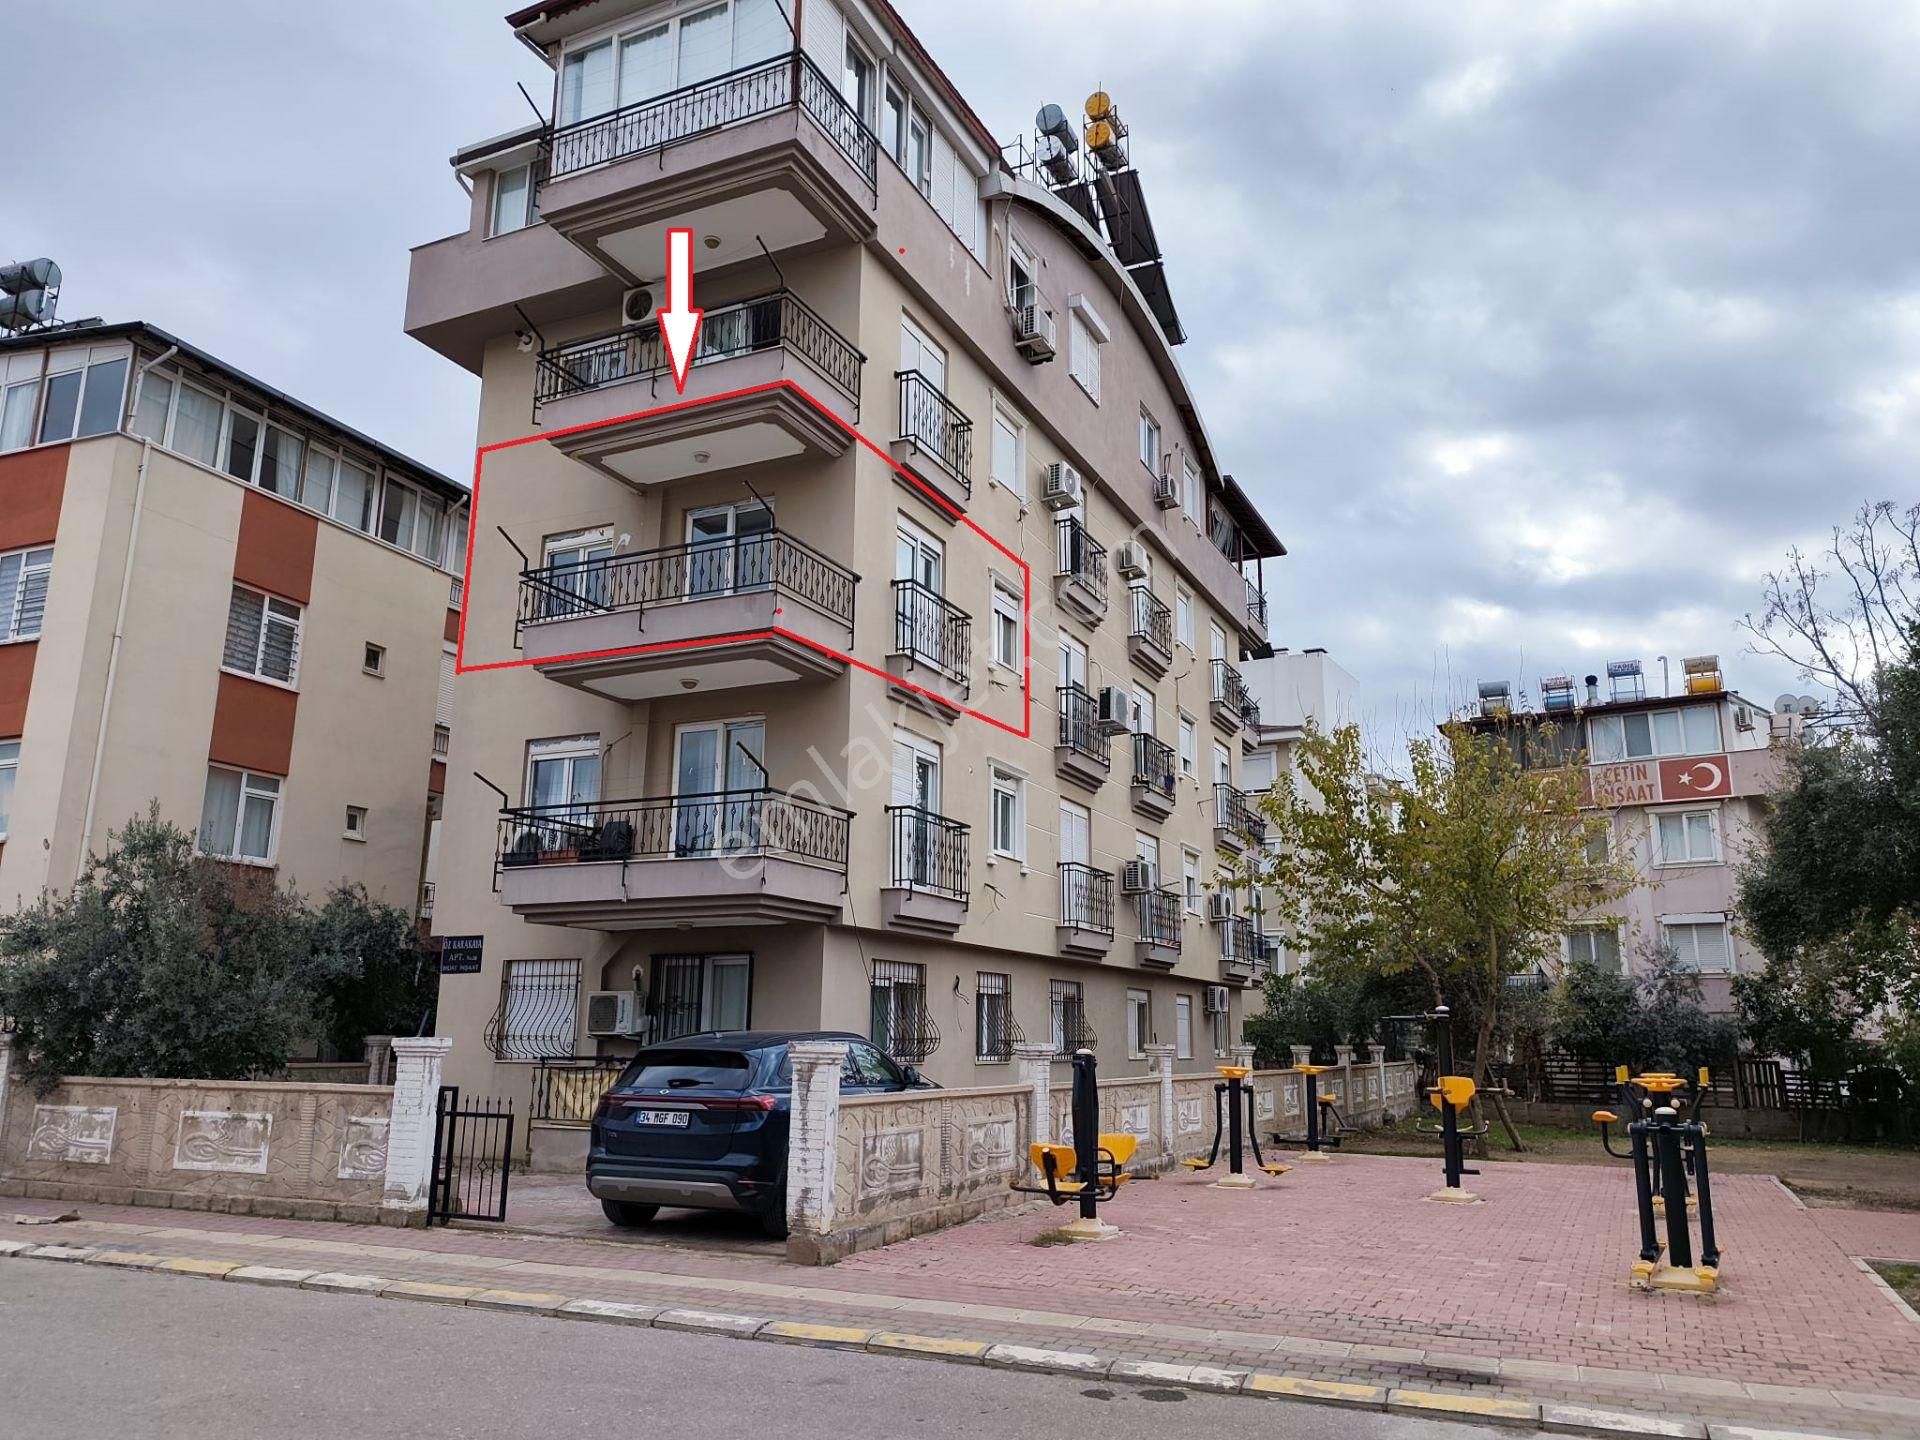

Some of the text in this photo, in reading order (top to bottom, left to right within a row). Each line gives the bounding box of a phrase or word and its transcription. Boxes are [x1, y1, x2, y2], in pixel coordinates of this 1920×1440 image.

[640, 1112, 688, 1125] 34 MGF 090
